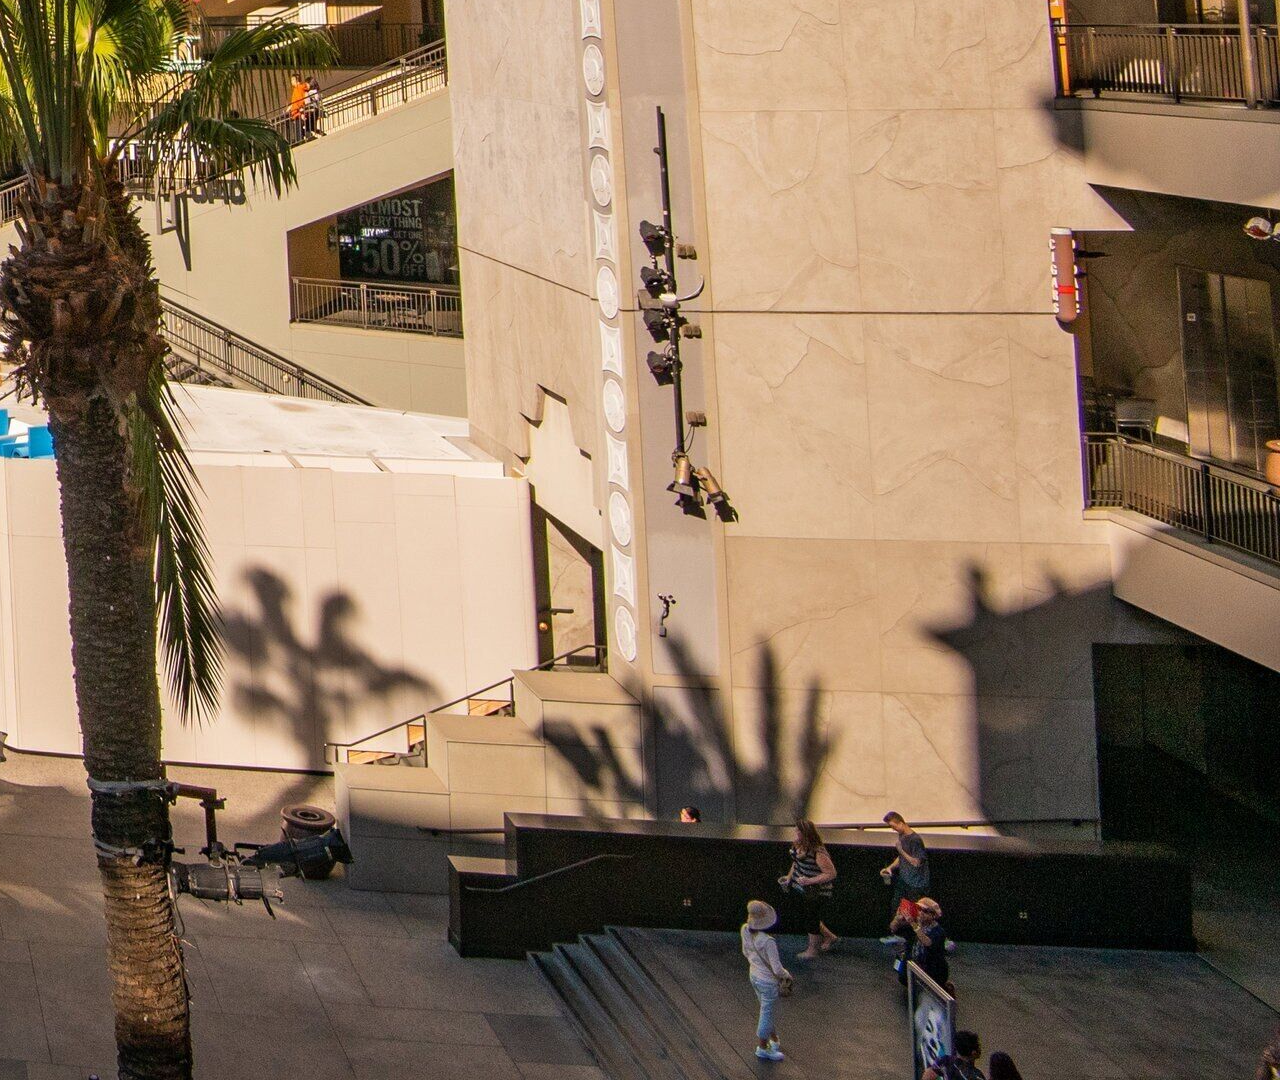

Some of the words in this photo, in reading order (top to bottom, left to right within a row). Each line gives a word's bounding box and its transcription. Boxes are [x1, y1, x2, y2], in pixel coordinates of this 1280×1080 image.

[361, 199, 423, 217] ALMOST
[361, 215, 422, 228] EVERYTHING
[361, 228, 374, 237] BUY
[362, 240, 424, 275] 50%
[402, 263, 425, 276] OFF
[1048, 238, 1059, 314] CIGARS
